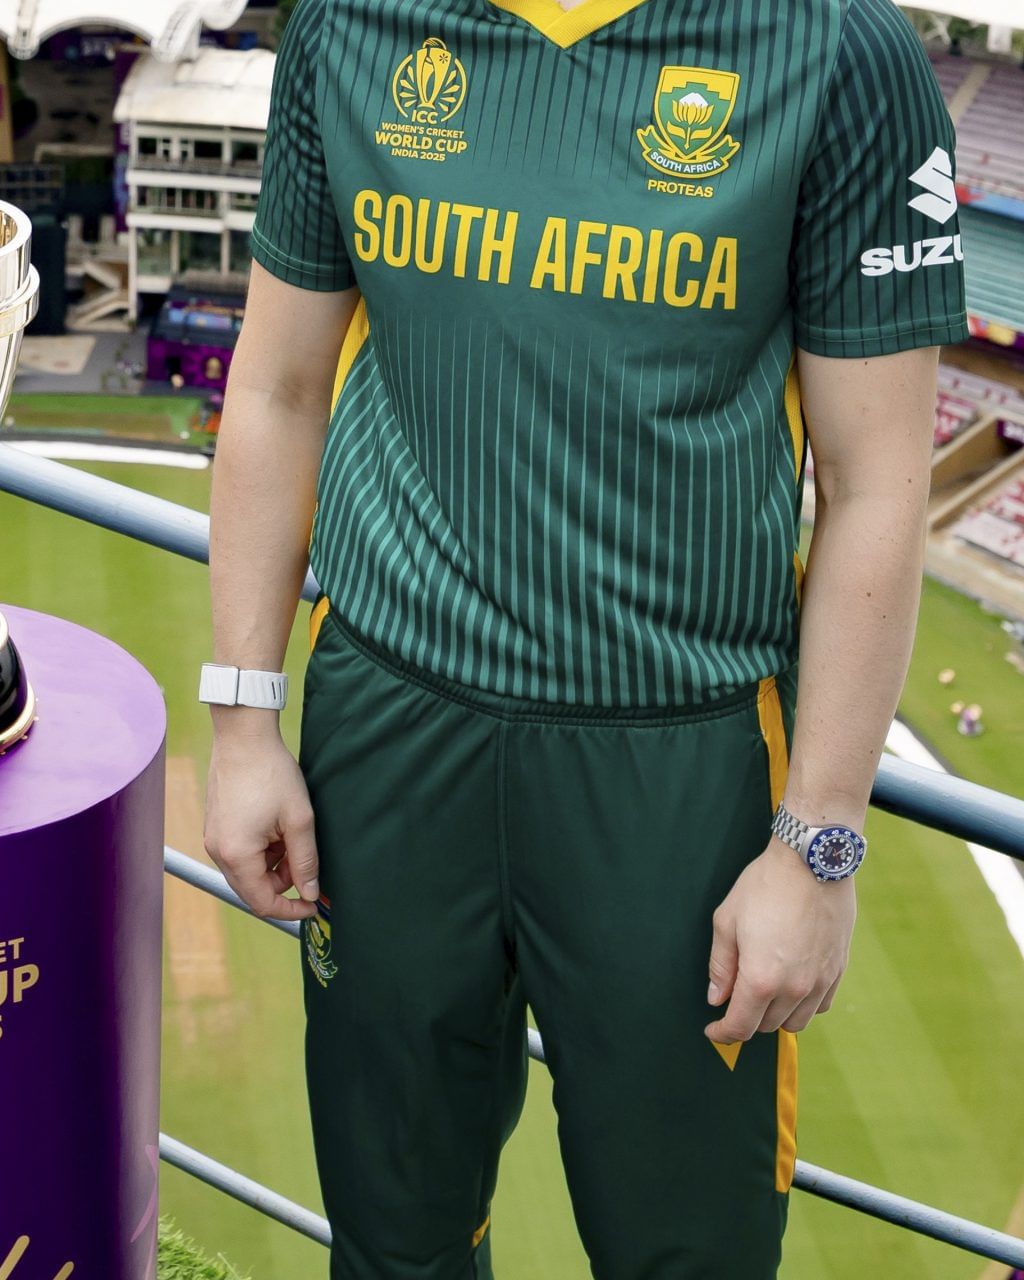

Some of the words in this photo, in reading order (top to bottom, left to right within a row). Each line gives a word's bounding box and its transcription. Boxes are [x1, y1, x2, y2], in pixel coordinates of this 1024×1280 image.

[411, 110, 439, 124] ICC
[381, 122, 424, 135] WOMEN'S
[426, 127, 464, 139] CRICKET
[375, 131, 432, 150] WORLD
[435, 139, 468, 154] CUP
[391, 148, 418, 159] INDIA
[420, 152, 446, 162] 2025
[650, 151, 682, 172] SOUTH
[683, 160, 721, 173] AFRICA
[647, 179, 714, 198] PROTEAS
[353, 189, 519, 285] SOUTH
[529, 216, 738, 311] AFRICA
